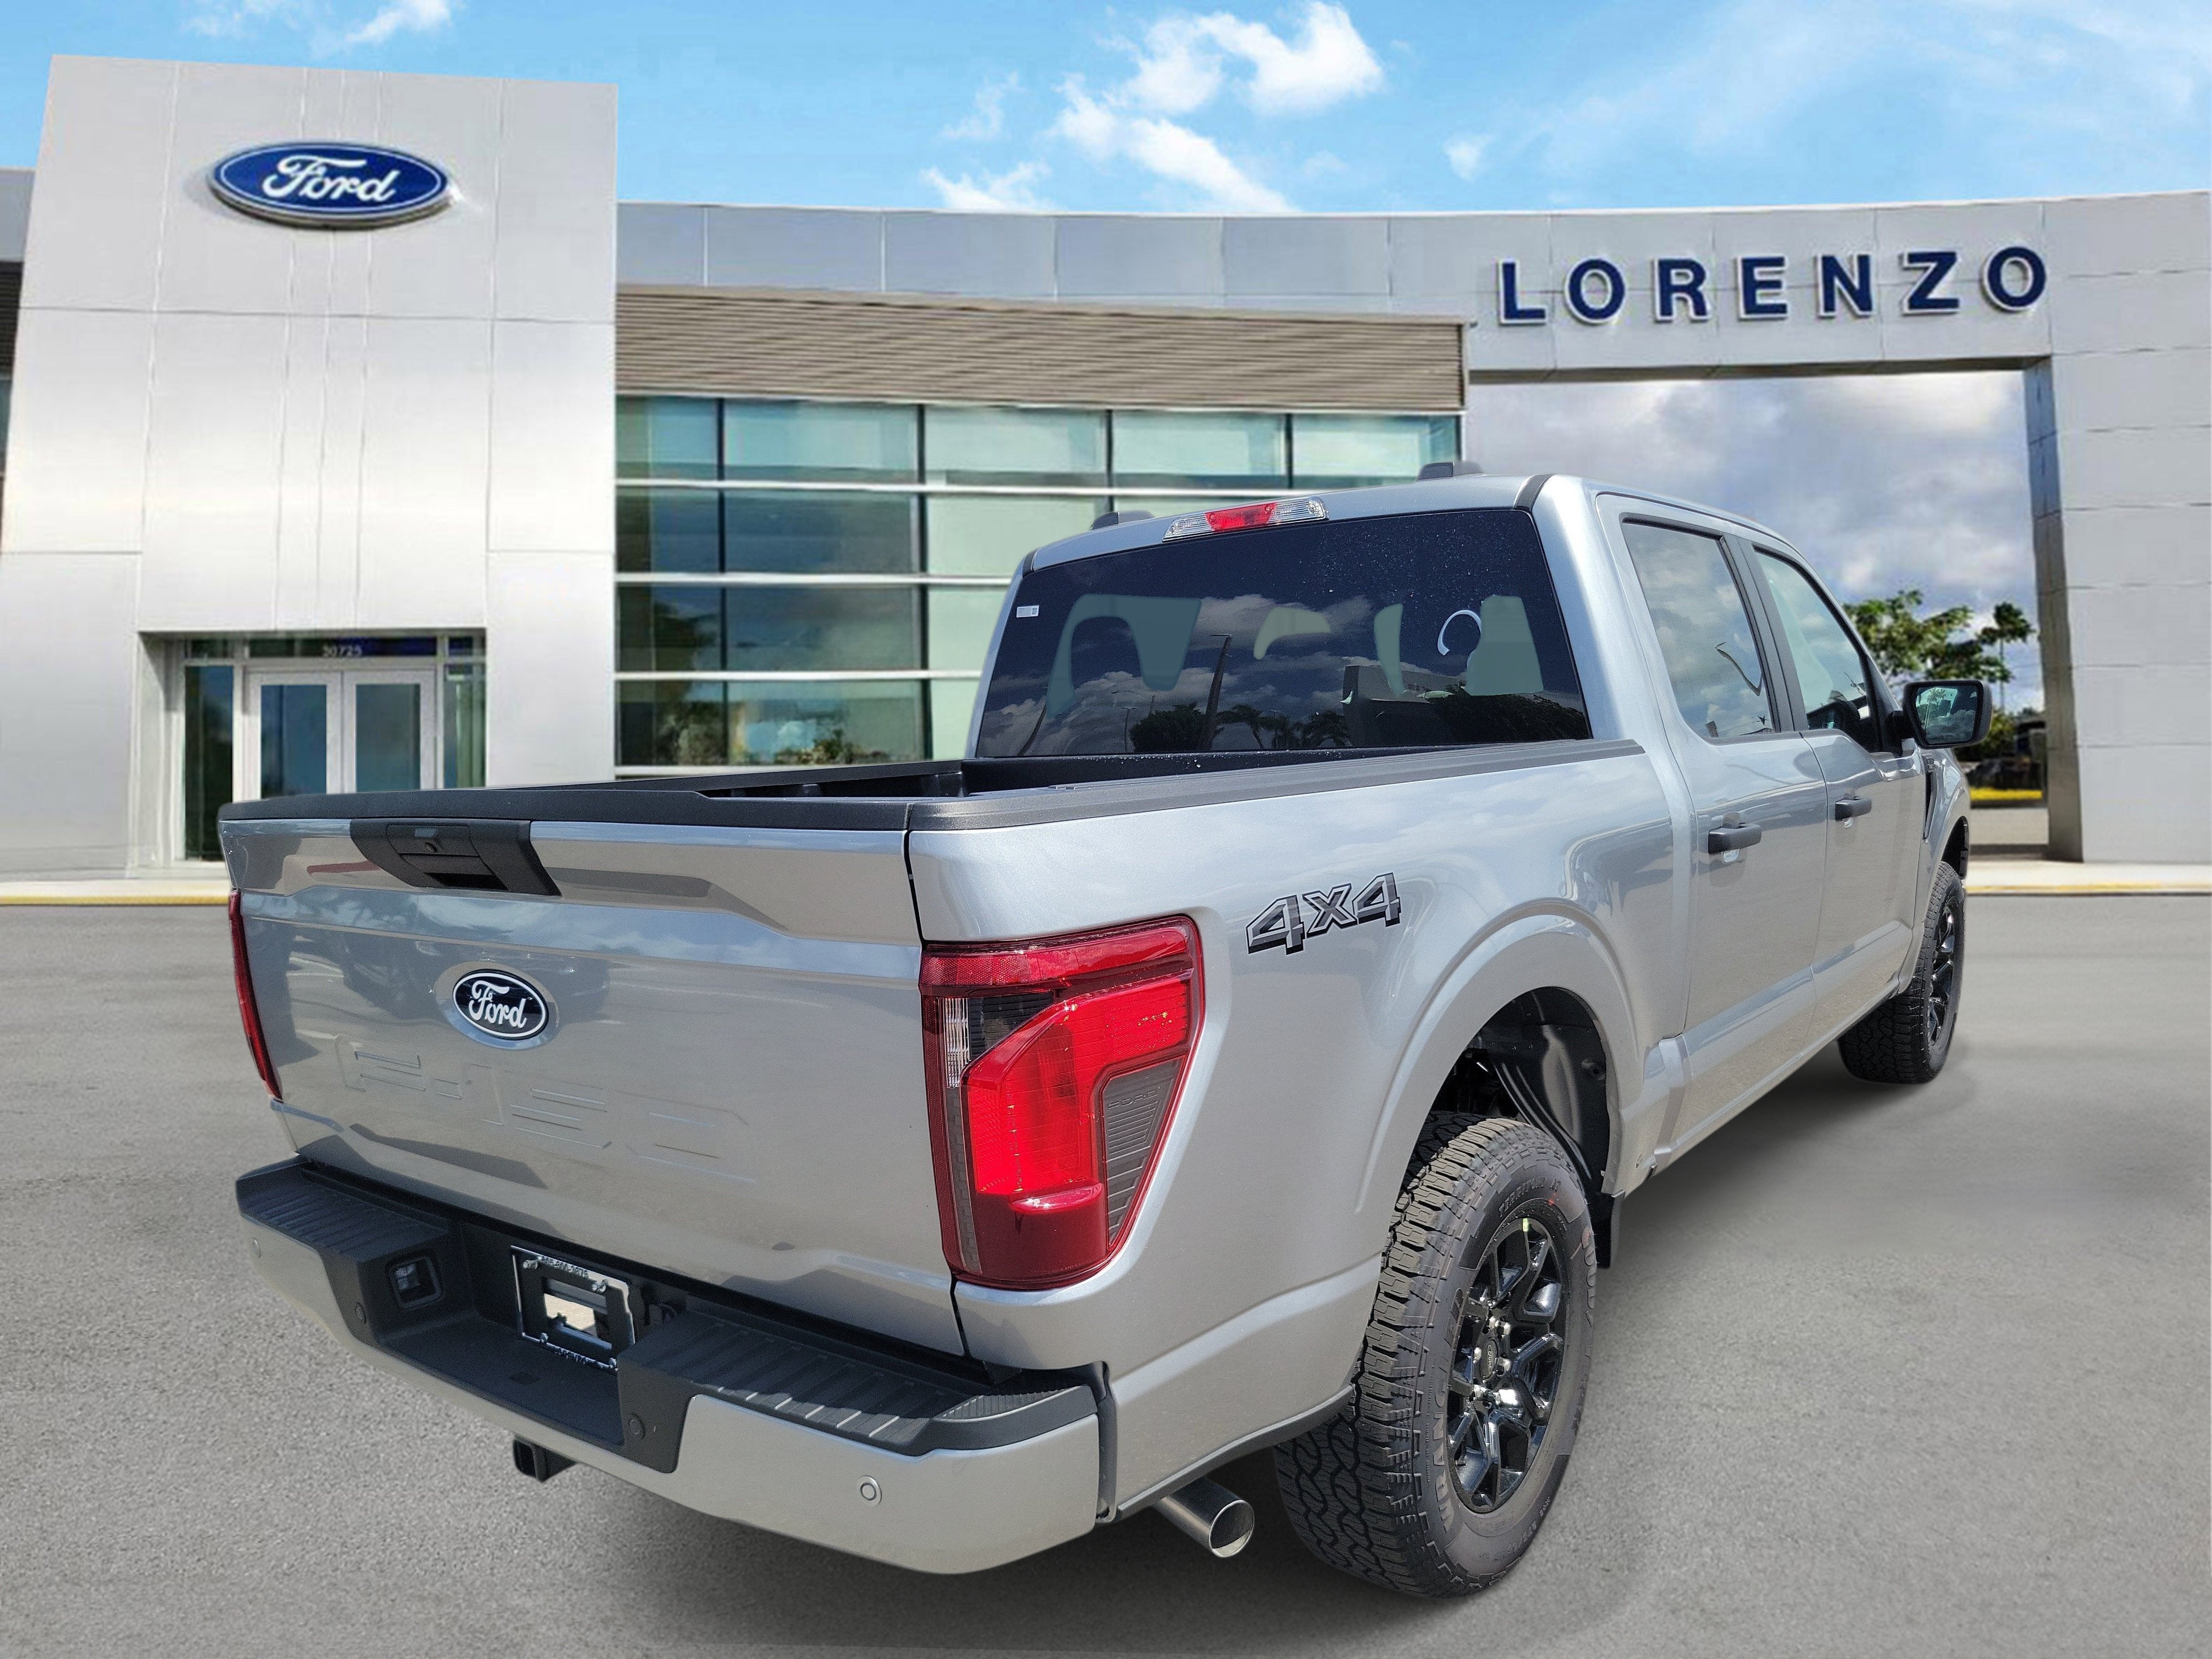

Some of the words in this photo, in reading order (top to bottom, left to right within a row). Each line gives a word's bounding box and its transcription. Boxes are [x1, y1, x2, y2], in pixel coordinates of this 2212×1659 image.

[262, 154, 401, 202] Ford
[1500, 245, 2047, 323] LORENZO
[469, 980, 527, 1029] Ford
[1107, 1090, 1157, 1112] FORD
[1432, 1287, 1463, 1534] WRANGLER
